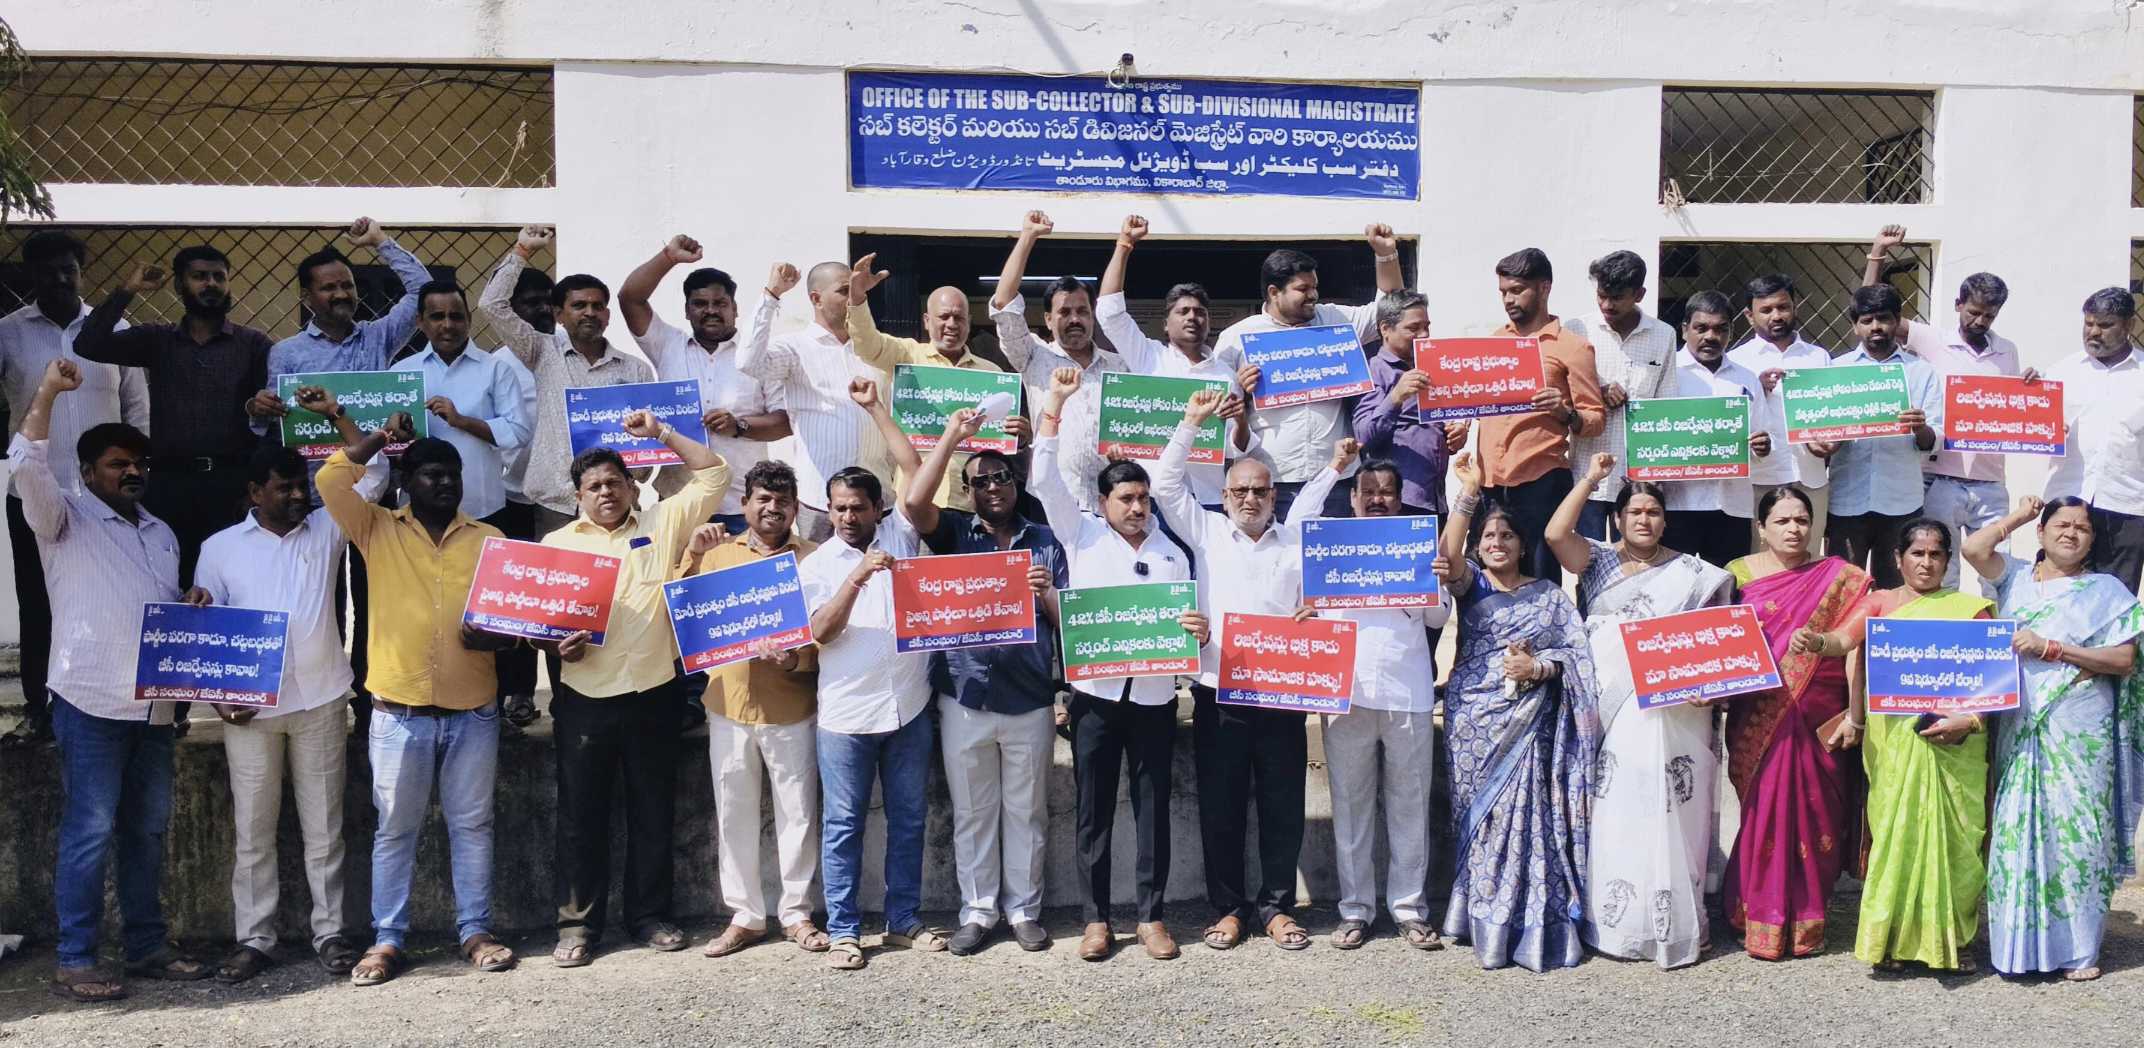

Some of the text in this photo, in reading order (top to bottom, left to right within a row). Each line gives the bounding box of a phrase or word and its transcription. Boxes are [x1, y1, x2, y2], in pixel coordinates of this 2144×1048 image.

[862, 86, 1416, 124] OFFICE OF THE SUB-COLLECTOR & SUB-DIVISIONAL MAGISTRATE
[858, 113, 894, 136] సబ్
[897, 113, 958, 145] కలెక్టర్
[962, 118, 1041, 139] మరియు
[1044, 116, 1080, 140] సబ్
[1082, 118, 1167, 142] డివిజనల్
[1248, 126, 1288, 146] వారి
[1291, 130, 1418, 157] కార్యాలయము
